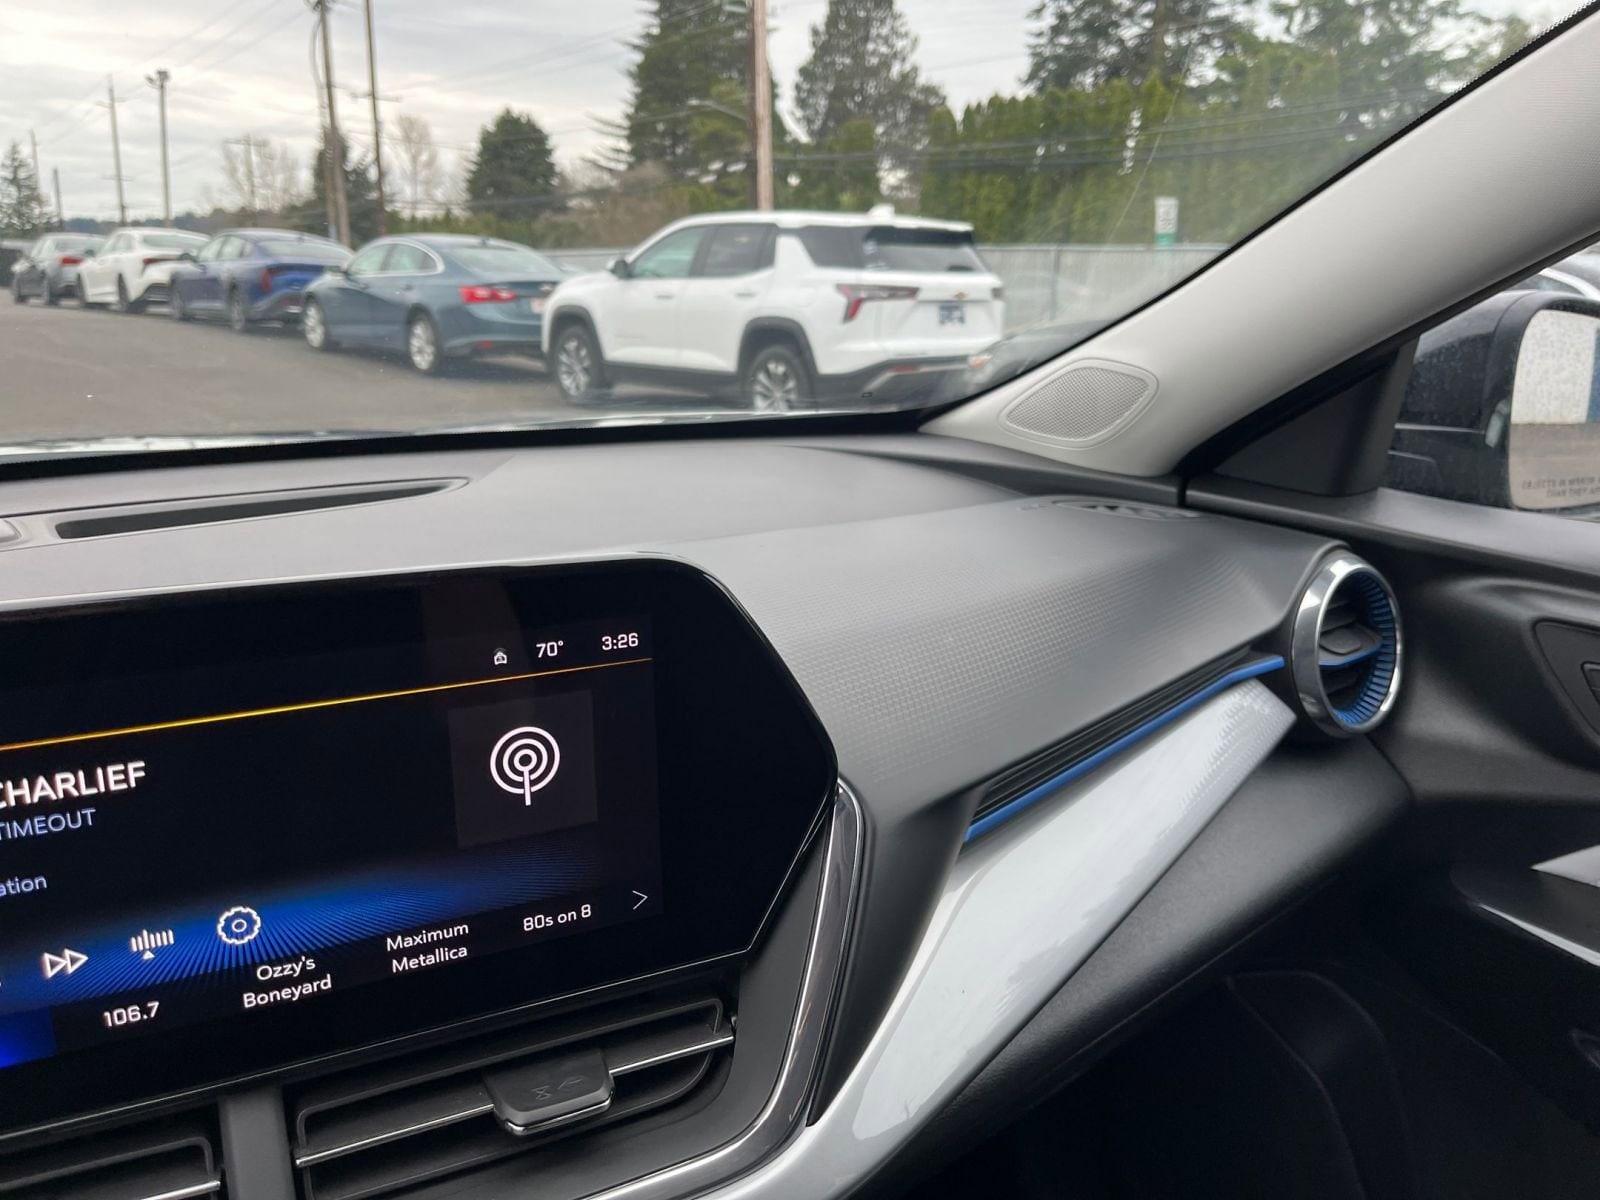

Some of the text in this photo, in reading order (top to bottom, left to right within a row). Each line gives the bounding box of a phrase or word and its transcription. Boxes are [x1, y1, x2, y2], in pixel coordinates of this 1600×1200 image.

[535, 640, 564, 658] 70°
[601, 632, 639, 650] 3:26
[523, 903, 592, 932] 80s on 8
[386, 922, 469, 952] Maximum
[256, 955, 317, 981] Ozzy's
[391, 945, 468, 974] Metallica
[242, 973, 333, 1009] Boneyard
[103, 1000, 160, 1028] 106.7
